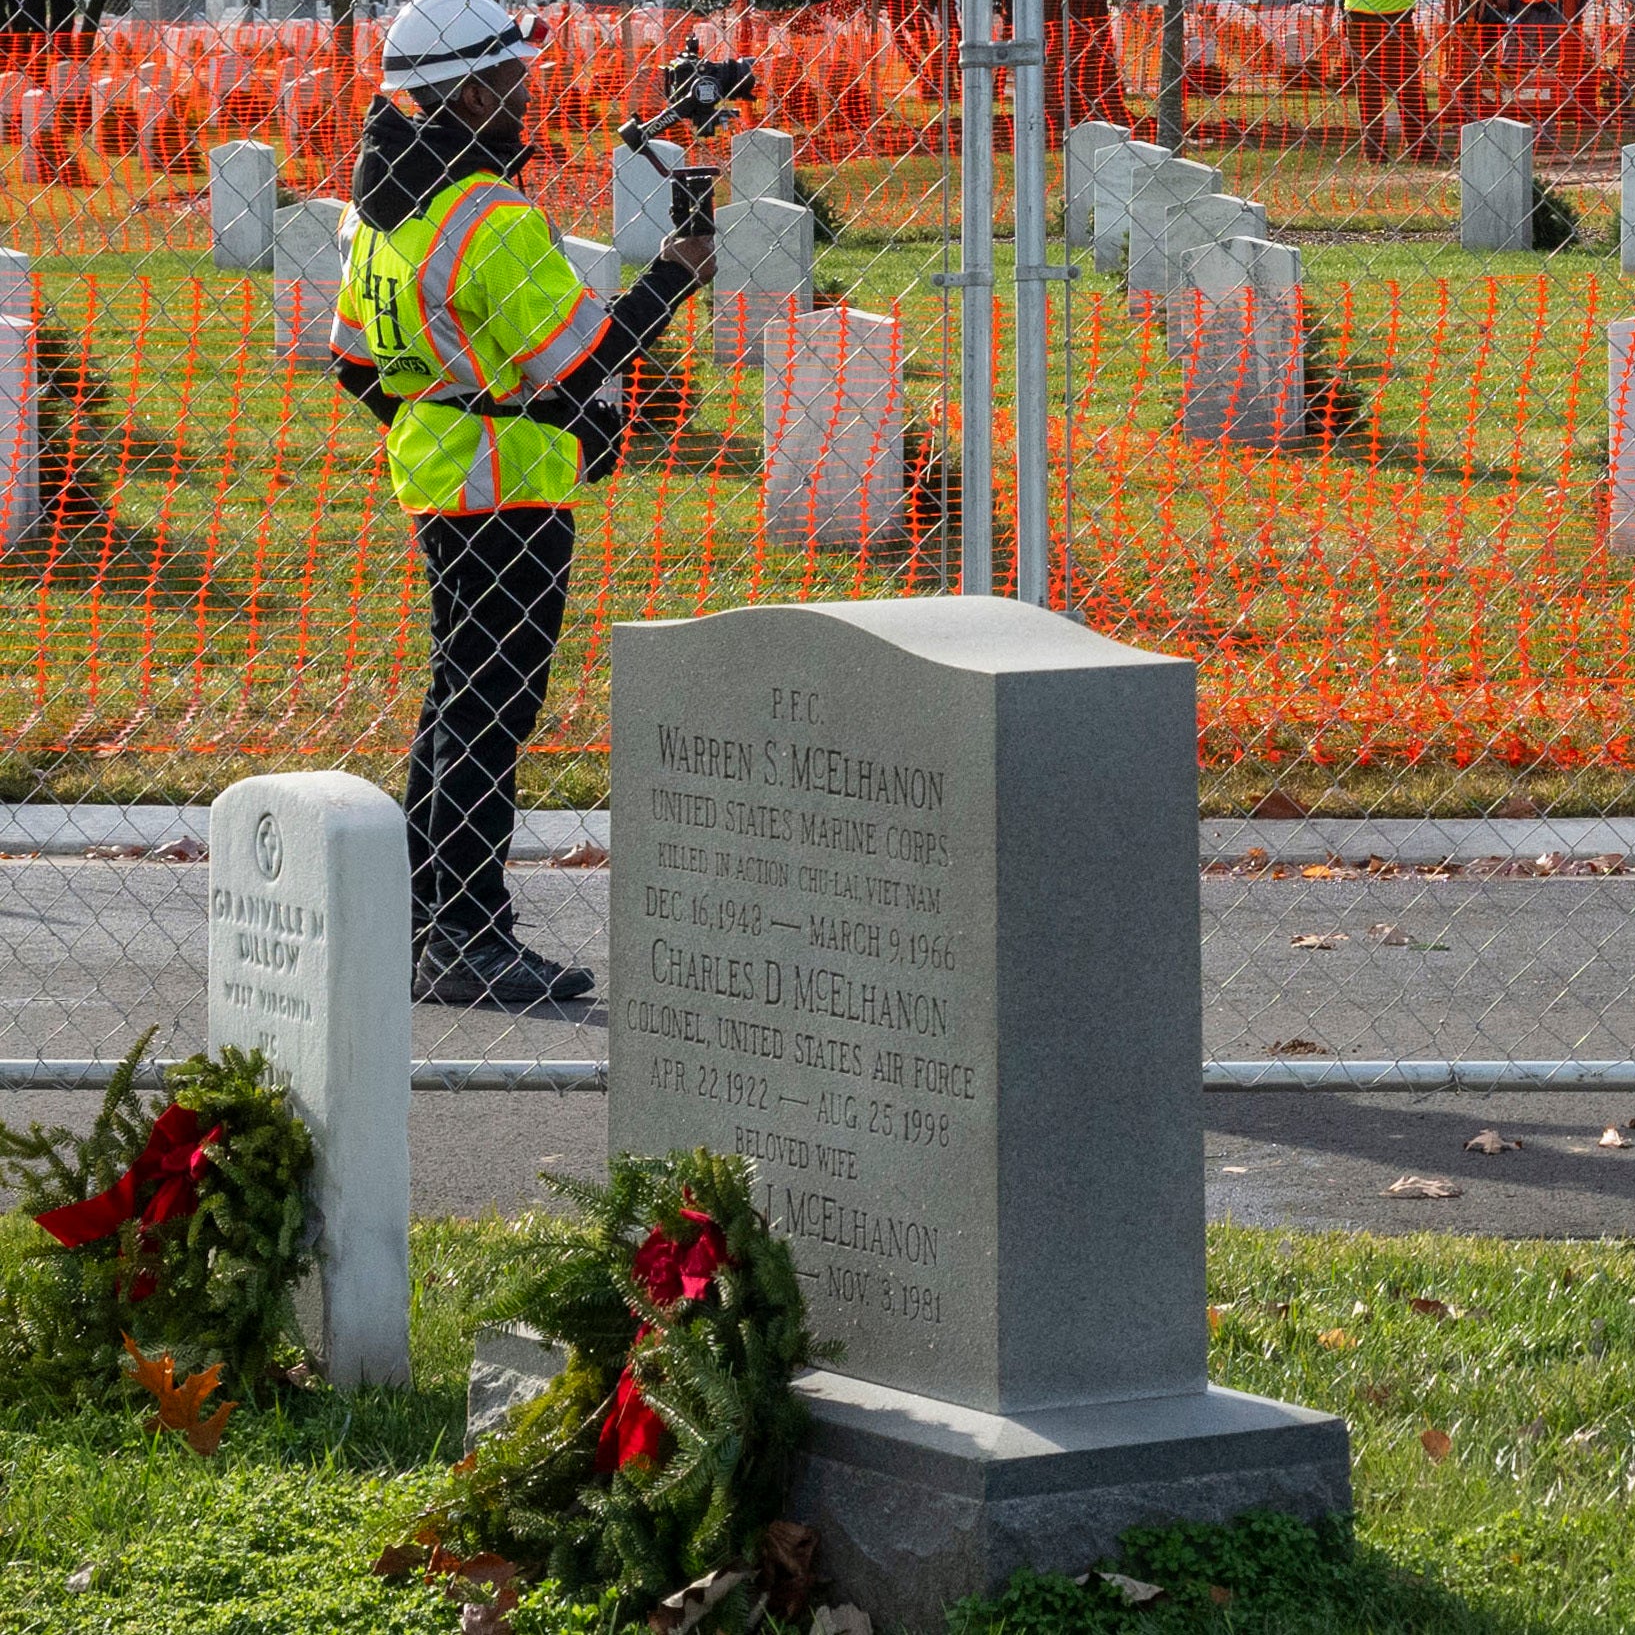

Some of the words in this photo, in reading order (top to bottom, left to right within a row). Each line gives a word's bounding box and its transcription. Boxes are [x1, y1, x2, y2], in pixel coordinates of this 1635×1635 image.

[658, 724, 753, 781] WARREN
[764, 740, 783, 786] S.
[652, 788, 717, 829] UNITED
[725, 800, 793, 842] STATES
[801, 812, 877, 855] MARINE
[886, 826, 950, 868] CORPS
[657, 842, 707, 874] KILLED
[716, 851, 730, 877] IN
[736, 856, 789, 887] ACTION
[866, 876, 901, 907] VIET
[810, 915, 881, 958] MARCH
[651, 938, 755, 1001] CHARLES
[717, 1016, 784, 1060] UNITED
[795, 1033, 862, 1077] STATES
[872, 1051, 904, 1087] AIR
[914, 1057, 976, 1100] FORCE
[735, 1126, 809, 1169] BELOVED
[815, 1144, 858, 1181] WIFE
